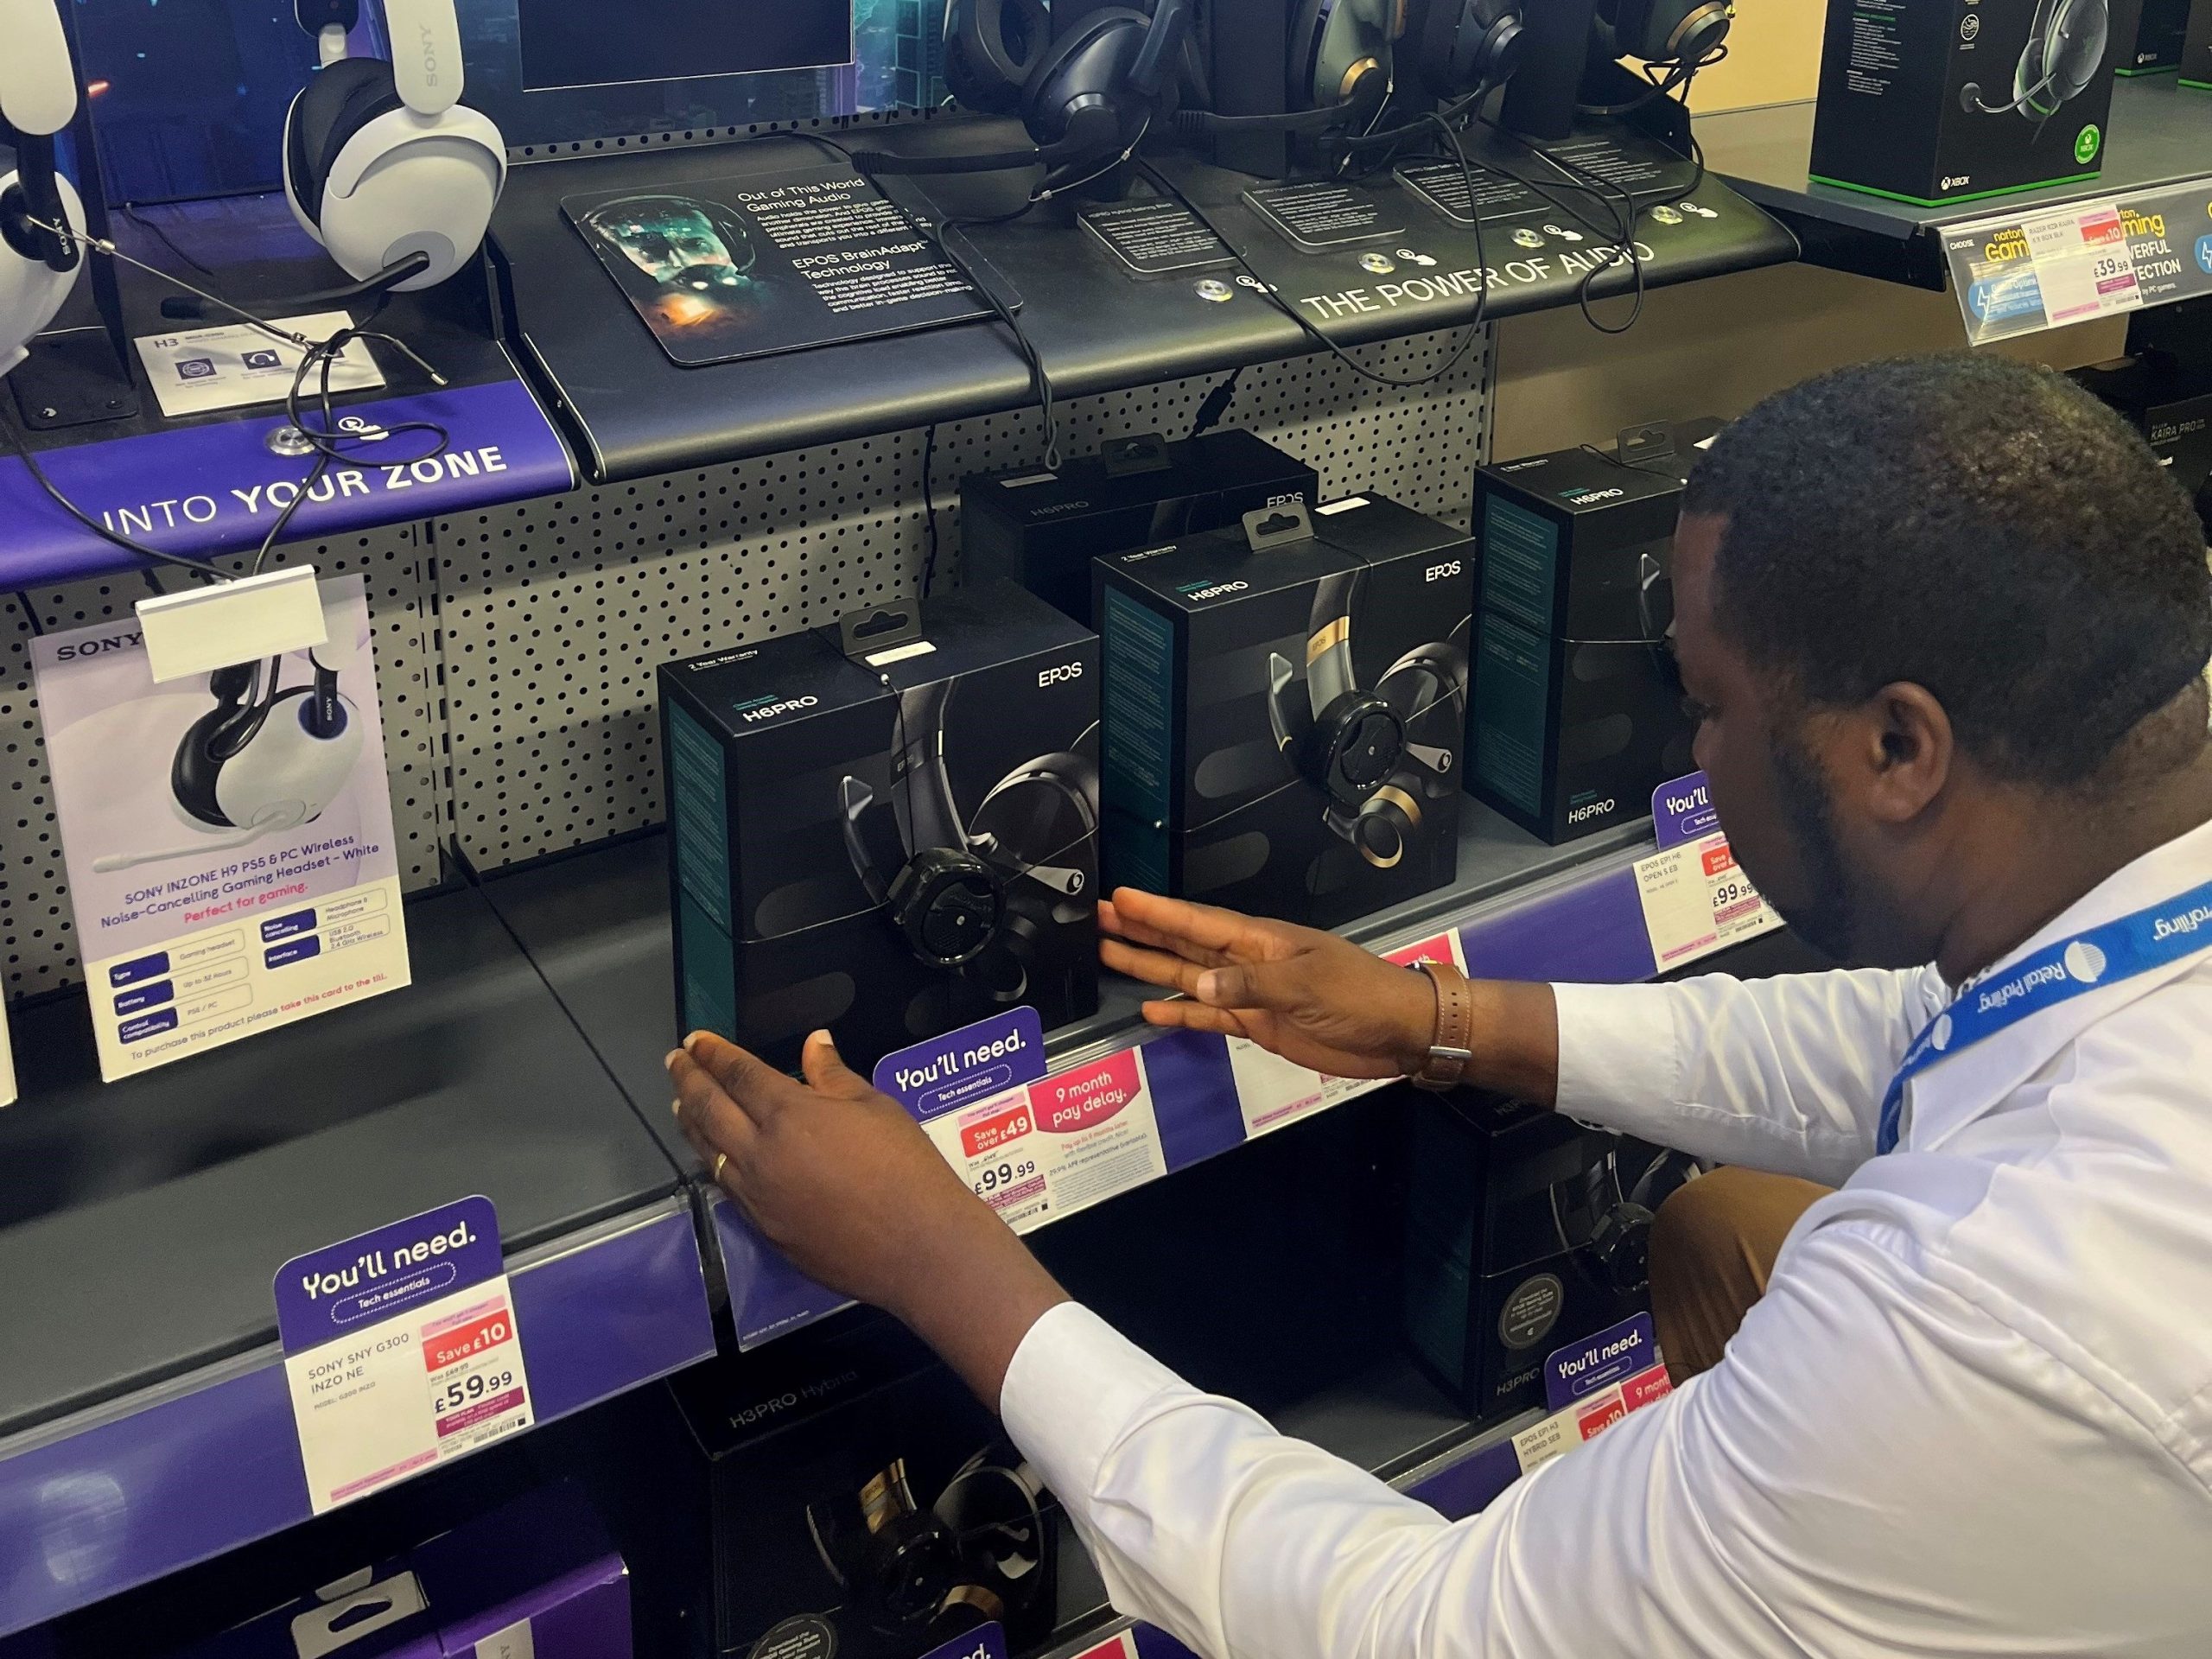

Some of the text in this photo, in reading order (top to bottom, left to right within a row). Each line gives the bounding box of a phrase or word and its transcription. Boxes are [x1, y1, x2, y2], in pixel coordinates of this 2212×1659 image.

[422, 24, 437, 87] SONY
[738, 178, 865, 202] Out of This World
[1950, 175, 1970, 187] XBOX
[747, 193, 851, 213] Gaming Audio
[1993, 228, 2024, 242] norton
[2122, 214, 2165, 237] ming
[1950, 239, 1974, 250] CHOOSE
[1986, 239, 2029, 261] Gam
[792, 254, 840, 270] EPOS
[800, 259, 890, 280] Technology
[2094, 258, 2129, 278] £39.99
[2134, 259, 2182, 281] ECTION
[1300, 287, 1382, 321] THE
[1381, 263, 1513, 308] POWER
[1509, 257, 1556, 284] OF
[154, 338, 179, 348] H3
[103, 446, 508, 536] INTO YOUR ZONE
[1267, 492, 1305, 509] EPOS
[1570, 488, 1624, 505] H6PRO
[1031, 499, 1089, 517] H6PRO
[1426, 560, 1462, 582] EPOS
[1188, 581, 1249, 601] H6PRO
[56, 631, 143, 662] SONY
[1039, 661, 1083, 688] EPOS
[743, 696, 818, 722] H6PRO
[1567, 798, 1615, 824] H6PRO
[1666, 785, 1708, 816] You'll
[125, 835, 354, 906] SONY INZONE H9 PS5 PC Wireless
[1642, 861, 1659, 872] EPOS
[1643, 871, 1662, 882] OPEN
[101, 843, 379, 928] Noise-Cancelling Gaming Headset White
[1713, 883, 1753, 907] £99.99
[183, 881, 308, 924] Perfect for gaming.
[2153, 904, 2212, 941] rofiling
[2023, 962, 2066, 993] Retail
[131, 1052, 143, 1060] To
[145, 1037, 188, 1058] purchase
[190, 1029, 206, 1041] this
[208, 1018, 245, 1037] product
[247, 1007, 278, 1025] please
[281, 999, 302, 1013] take
[304, 994, 319, 1005] this
[321, 986, 342, 998] card
[356, 976, 371, 987] the
[895, 1028, 1027, 1092] You'll need.
[938, 1075, 993, 1103] Tech essentials
[1056, 1071, 1112, 1103] 9 month
[1052, 1088, 1127, 1128] pay delay.
[975, 1128, 997, 1141] Save
[977, 1116, 1028, 1150] over £49
[975, 1160, 1035, 1195] £99.99
[302, 1220, 476, 1300] You'll need.
[358, 1275, 431, 1310] Tech essentials
[436, 1322, 505, 1363] Save £10
[1559, 1329, 1643, 1379] You'll need.
[308, 1332, 410, 1381] SONY SNY G300
[311, 1365, 365, 1395] INZO NE
[435, 1370, 512, 1414] £59.99
[1496, 1366, 1540, 1397] H3PRO
[1636, 1387, 1643, 1398] 9
[728, 1369, 859, 1430] H3PRO Hybrid
[1520, 1434, 1538, 1446] EPOS
[1549, 1422, 1559, 1432] H3
[1523, 1433, 1560, 1457] HYBRID SEB
